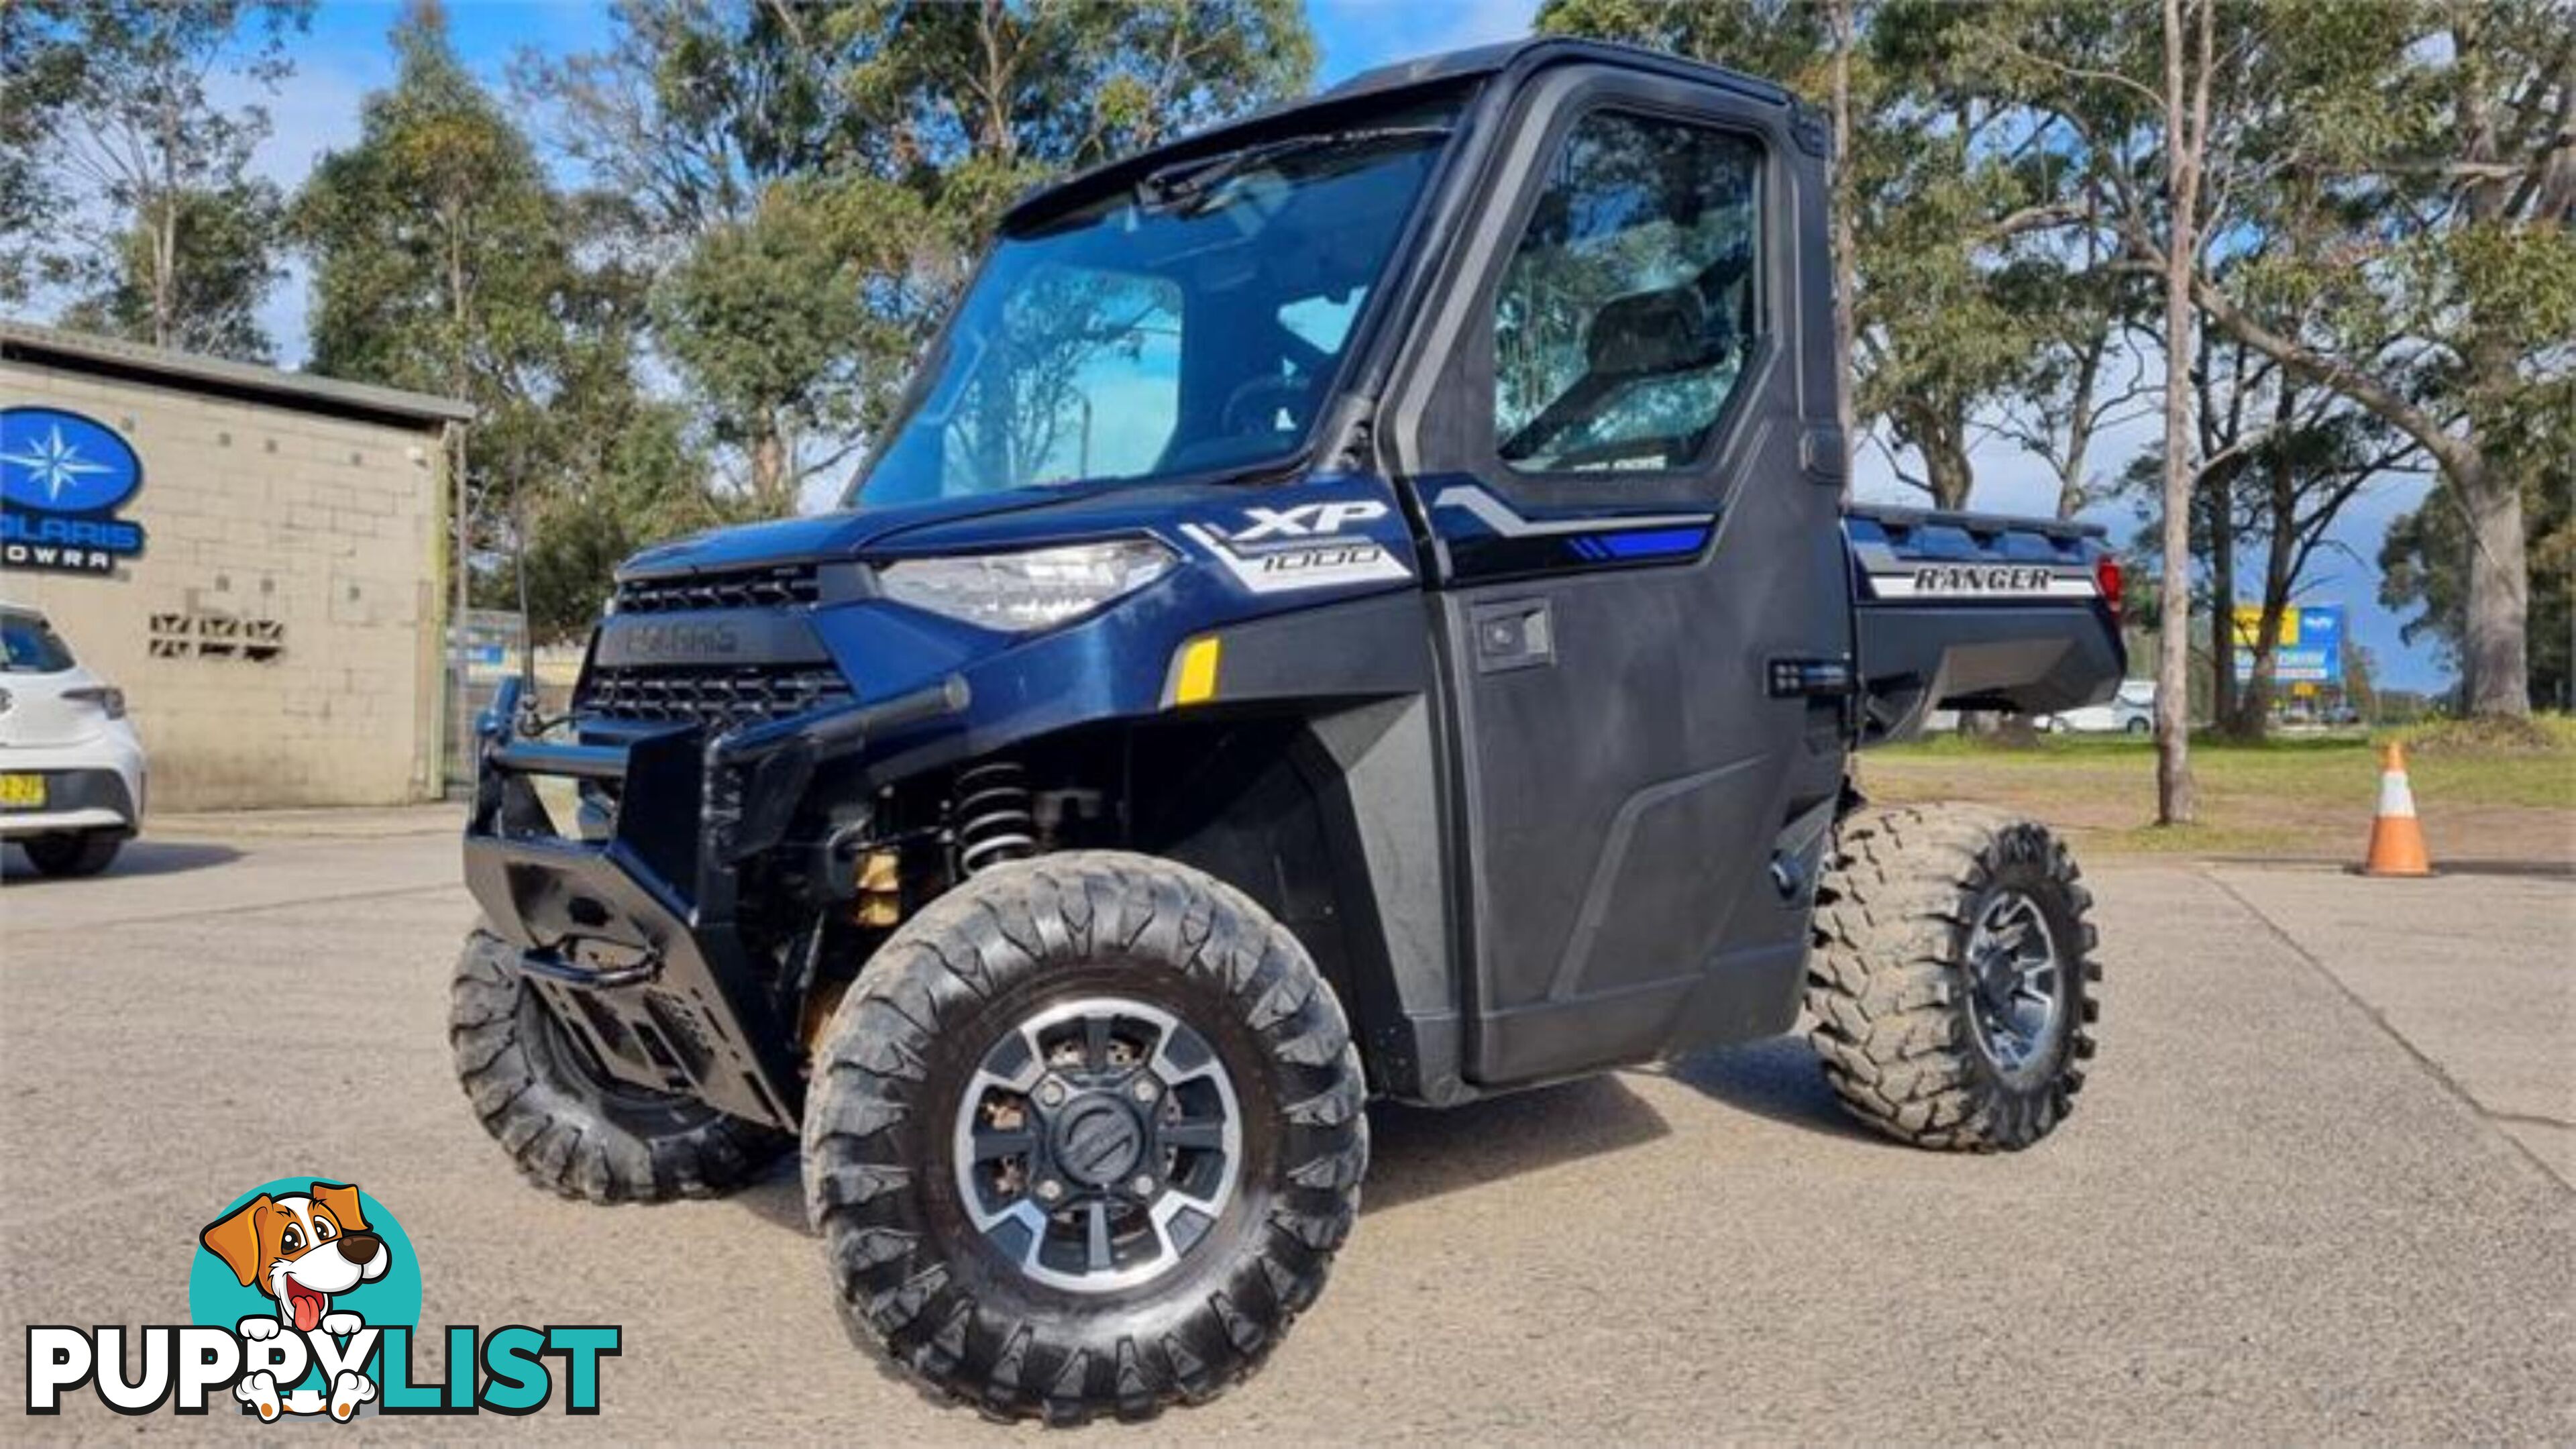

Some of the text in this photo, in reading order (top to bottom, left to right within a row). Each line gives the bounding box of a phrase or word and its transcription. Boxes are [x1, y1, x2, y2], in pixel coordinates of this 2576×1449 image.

[1233, 500, 1389, 539] XP
[1264, 548, 1381, 572] 1000
[1915, 568, 2051, 589] RANGER
